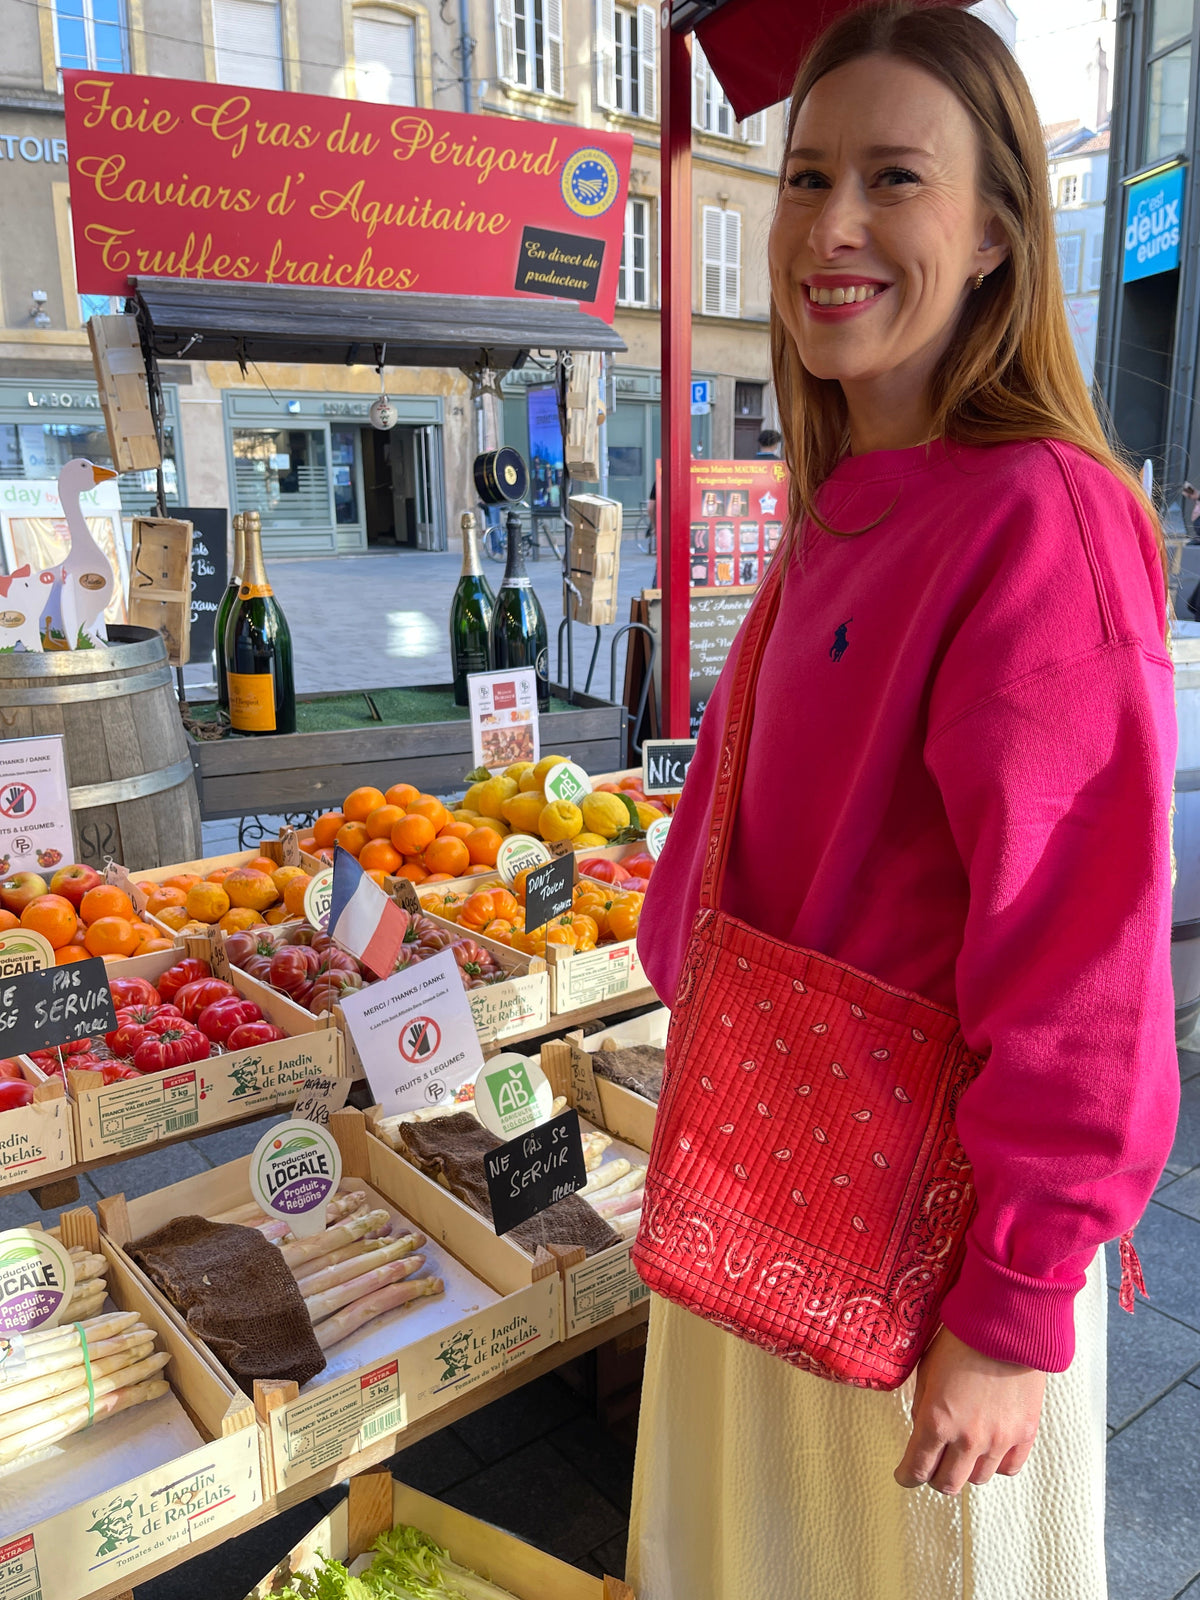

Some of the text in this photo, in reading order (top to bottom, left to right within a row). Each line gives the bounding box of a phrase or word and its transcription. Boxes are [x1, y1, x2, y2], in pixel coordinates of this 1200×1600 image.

[74, 81, 559, 183] Foie Gras du Périgord
[77, 154, 260, 212] Caviars
[310, 180, 511, 239] Aquitaine
[1137, 189, 1164, 218] C'est
[1125, 198, 1179, 250] deux
[85, 224, 258, 279] Truffes
[525, 241, 599, 269] En direct du
[1137, 226, 1179, 263] euros
[525, 270, 589, 290] producteur
[4, 485, 40, 505] day
[197, 559, 217, 576] Bio
[30, 755, 51, 763] DANKE
[560, 779, 577, 801] AB
[20, 822, 55, 832] LEGUMES
[52, 970, 81, 993] PAS
[363, 1002, 387, 1017] MERCI
[391, 986, 418, 1003] THANKS
[423, 973, 446, 988] DANKE
[35, 987, 109, 1029] SERVIR
[171, 1077, 188, 1086] EXTRA
[394, 1076, 422, 1096] FRUITS
[430, 1052, 466, 1076] LEGUMES
[178, 1089, 188, 1097] kg
[499, 1079, 529, 1115] AB
[102, 1109, 124, 1119] FRANCE
[145, 1097, 161, 1106] LOIRE
[501, 1103, 540, 1124] AGRICULTURE
[503, 1111, 542, 1130] BIOLOGIQUE
[272, 1150, 318, 1170] Production
[489, 1154, 510, 1178] NE
[510, 1146, 568, 1197] SERVIR
[9, 1169, 28, 1178] Loire
[266, 1154, 329, 1197] LOCALE
[284, 1180, 319, 1199] Produit
[286, 1191, 321, 1210] Régions
[0, 1294, 46, 1317] Produit
[4, 1305, 50, 1329] Régions
[369, 1370, 390, 1384] EXTRA
[455, 1373, 480, 1391] Tomates
[491, 1363, 501, 1371] Val
[510, 1350, 526, 1361] Loire
[378, 1384, 390, 1394] kg
[290, 1421, 316, 1437] FRANCE
[316, 1415, 329, 1423] VAL
[339, 1400, 358, 1413] LOIRE
[291, 1406, 313, 1418] TOMATES
[116, 1547, 152, 1567] Tomates
[154, 1539, 165, 1549] du
[166, 1532, 180, 1543] Val
[193, 1515, 215, 1529] Loire
[7, 1563, 23, 1576] kg
